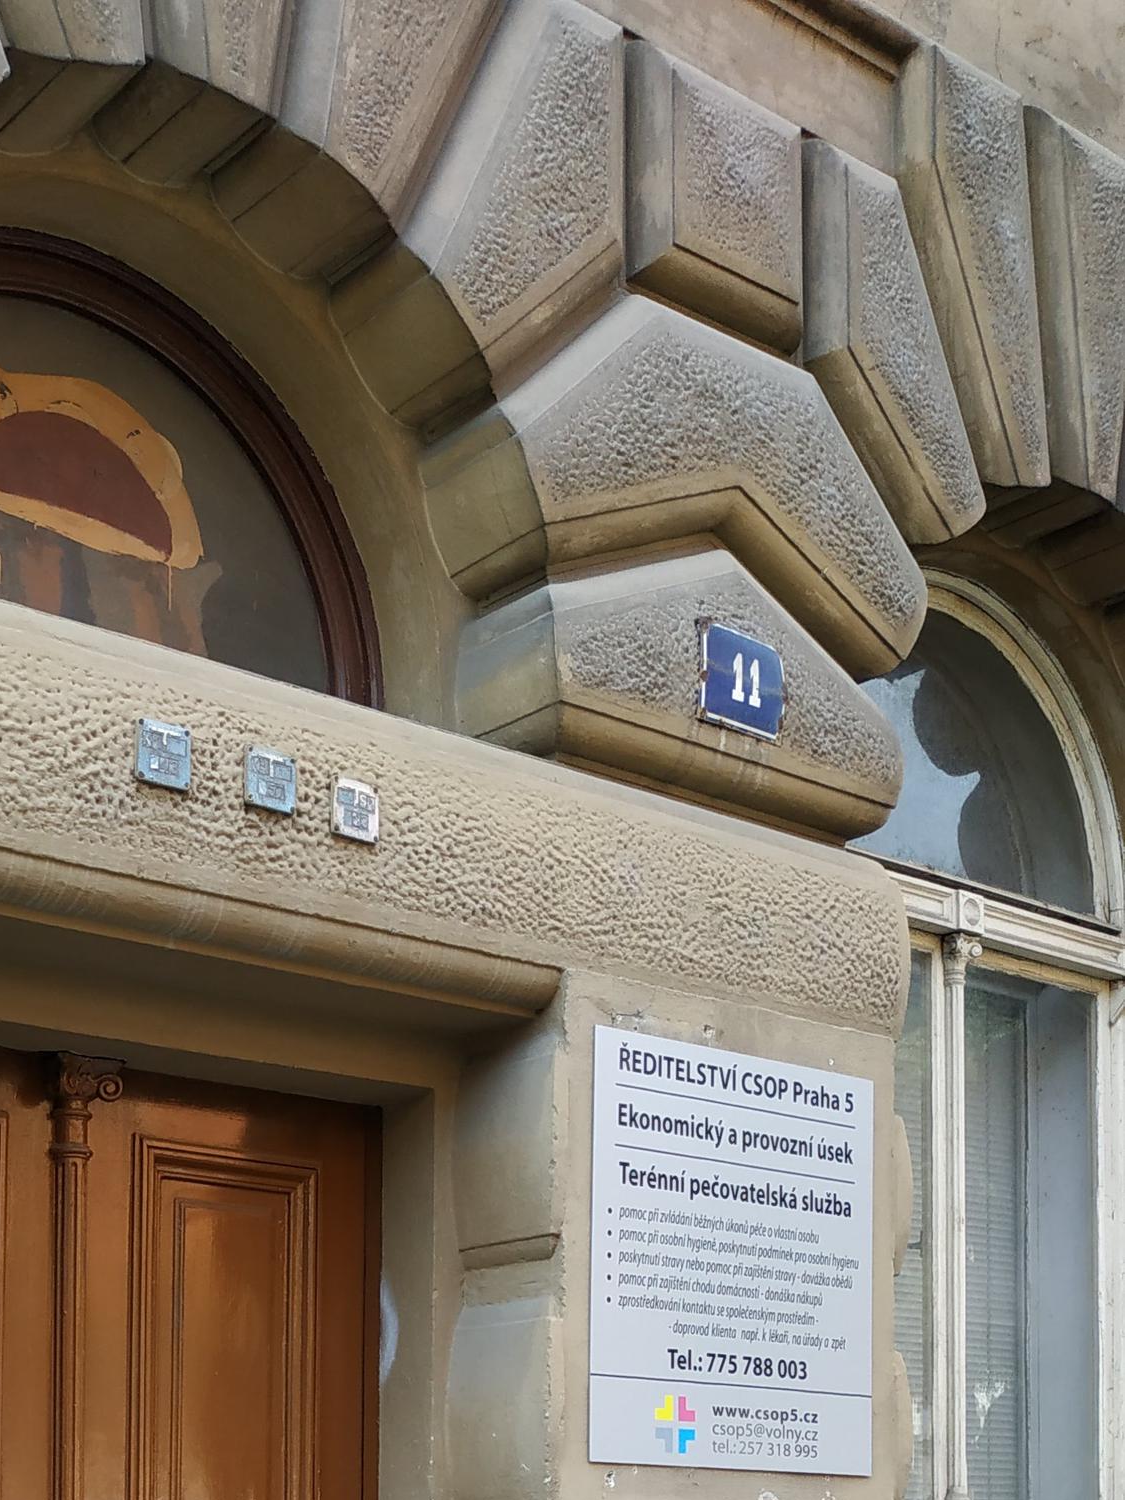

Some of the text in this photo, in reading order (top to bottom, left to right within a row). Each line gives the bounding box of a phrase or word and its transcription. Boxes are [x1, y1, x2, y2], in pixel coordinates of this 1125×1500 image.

[732, 652, 761, 708] 11
[618, 1042, 854, 1113] ŘEDITELSTVÍ CSOP Praha 5
[618, 1103, 853, 1165] Ekonomický a provozní úsek
[619, 1161, 852, 1218] Terénní pečovatelská služba
[619, 1207, 819, 1244] pomoc při zvládání běžných úkonů péče o vlastní osobu
[619, 1229, 647, 1243] pomoc
[647, 1230, 659, 1246] při
[660, 1232, 686, 1247] osobní
[718, 1239, 757, 1258] poskytnutí
[758, 1244, 793, 1261] podmínek
[795, 1251, 806, 1265] pro
[808, 1250, 832, 1266] osobní
[832, 1254, 859, 1272] hygienu
[618, 1249, 660, 1268] poskytnutí
[661, 1254, 685, 1272] stravy
[686, 1256, 705, 1271] nebo
[706, 1261, 732, 1275] pomoc
[733, 1263, 743, 1278] při
[744, 1264, 774, 1281] zajištění
[775, 1268, 796, 1285] stravy
[801, 1270, 830, 1287] dovážka
[831, 1274, 853, 1289] obědů
[618, 1273, 647, 1287] pomoc
[647, 1274, 659, 1290] při
[659, 1275, 691, 1293] zajištění
[691, 1279, 715, 1294] chodu
[716, 1282, 760, 1300] domácnosti
[765, 1286, 795, 1303] donáška
[796, 1291, 823, 1308] nákupů
[618, 1294, 680, 1313] zprostředkování
[682, 1298, 716, 1316] kontaktu
[716, 1306, 724, 1317] se
[725, 1304, 776, 1325] společenským
[776, 1311, 815, 1326] prostředím
[673, 1320, 710, 1338] doprovod
[711, 1322, 737, 1338] klienta
[741, 1327, 760, 1343] např.
[762, 1328, 767, 1341] k
[769, 1328, 790, 1346] lékaři,
[792, 1334, 801, 1345] na
[803, 1333, 824, 1351] úřady
[824, 1337, 829, 1348] a
[831, 1336, 846, 1352] zpět
[667, 1349, 808, 1380] Tel.: 775 788 003
[712, 1404, 818, 1425] www.csop5.cz
[712, 1422, 818, 1443] csop5@volny.cz
[712, 1440, 818, 1459] tel.: 257 318 995
